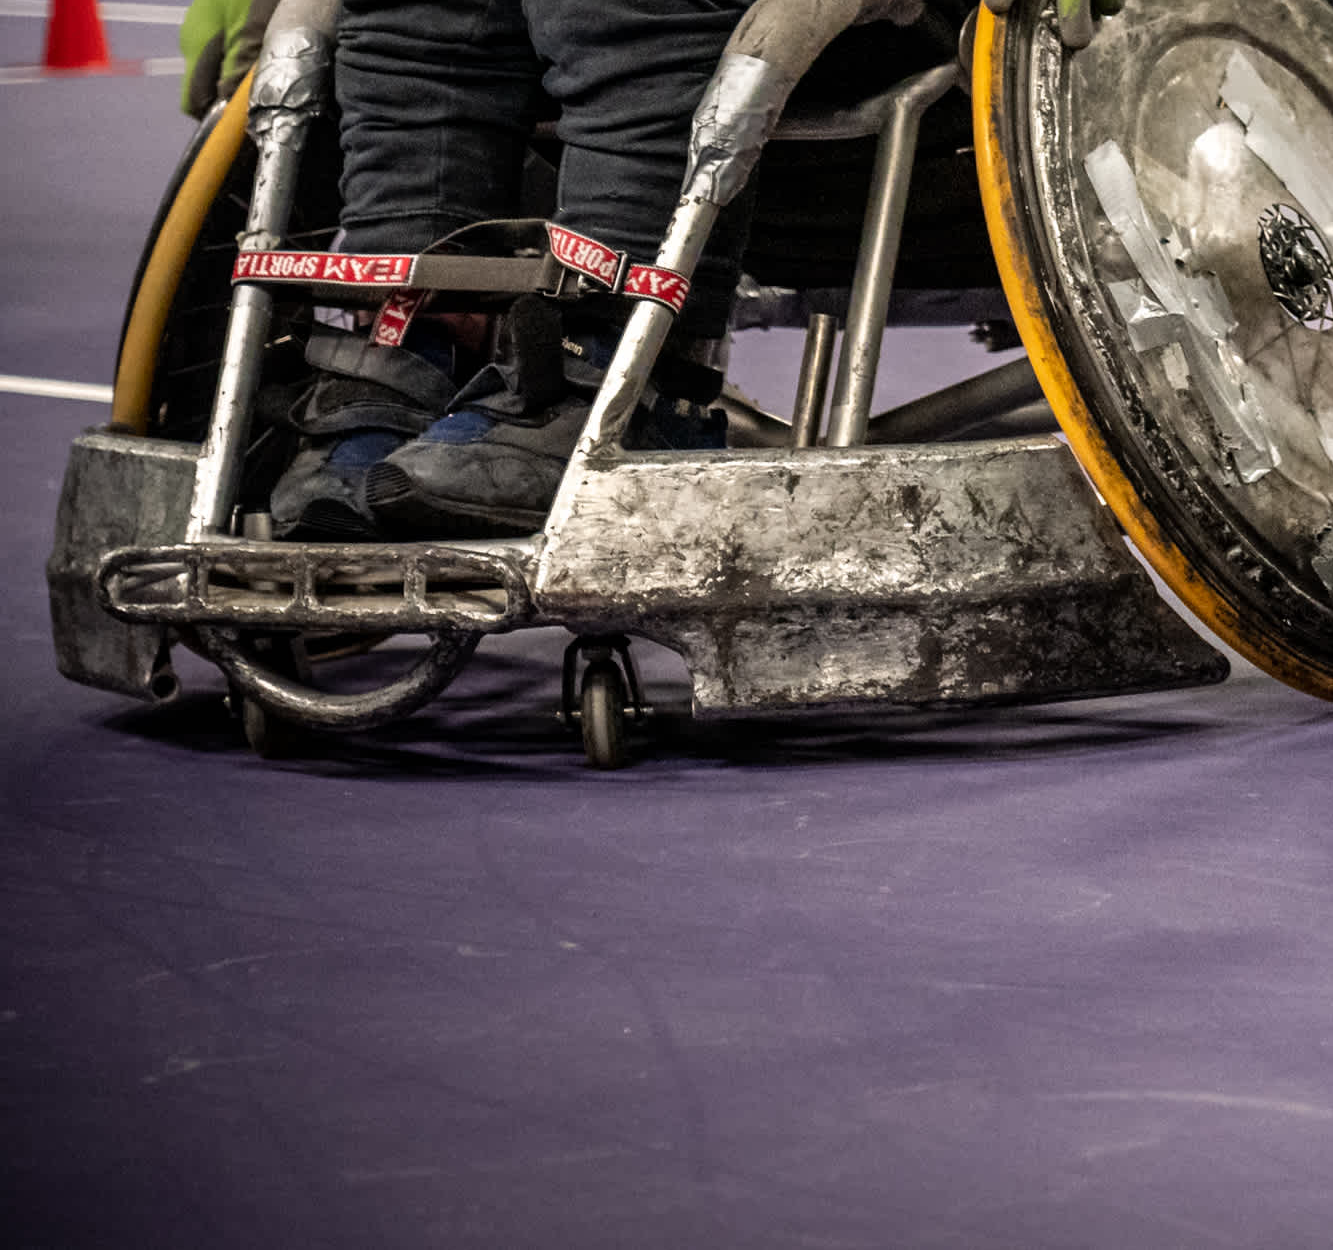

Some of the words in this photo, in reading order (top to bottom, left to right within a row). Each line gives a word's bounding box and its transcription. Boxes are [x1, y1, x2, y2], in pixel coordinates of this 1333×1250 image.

[237, 254, 320, 279] SPORTIA
[551, 228, 619, 283] PORTIA
[322, 257, 404, 283] TEAM
